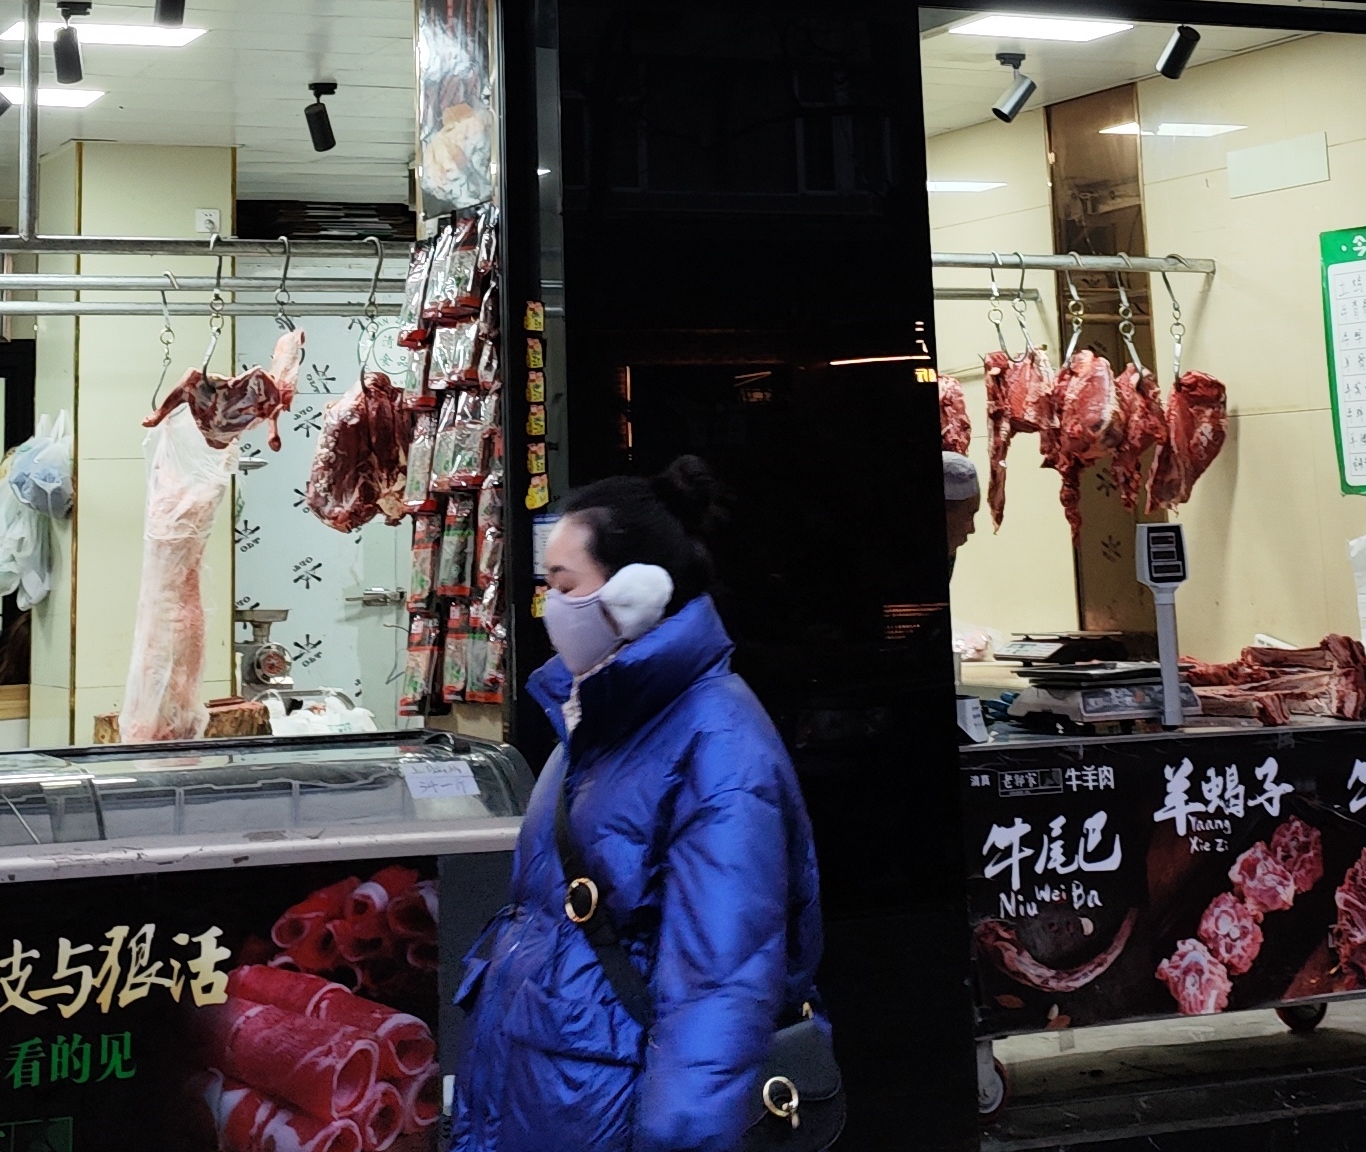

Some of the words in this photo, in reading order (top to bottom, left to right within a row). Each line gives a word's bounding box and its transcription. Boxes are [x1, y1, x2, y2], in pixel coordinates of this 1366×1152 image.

[1065, 765, 1115, 792] 牛羊肉
[1153, 756, 1295, 836] 羊蝎子
[982, 810, 1123, 892] 牛尾巴
[999, 891, 1039, 919] Niu
